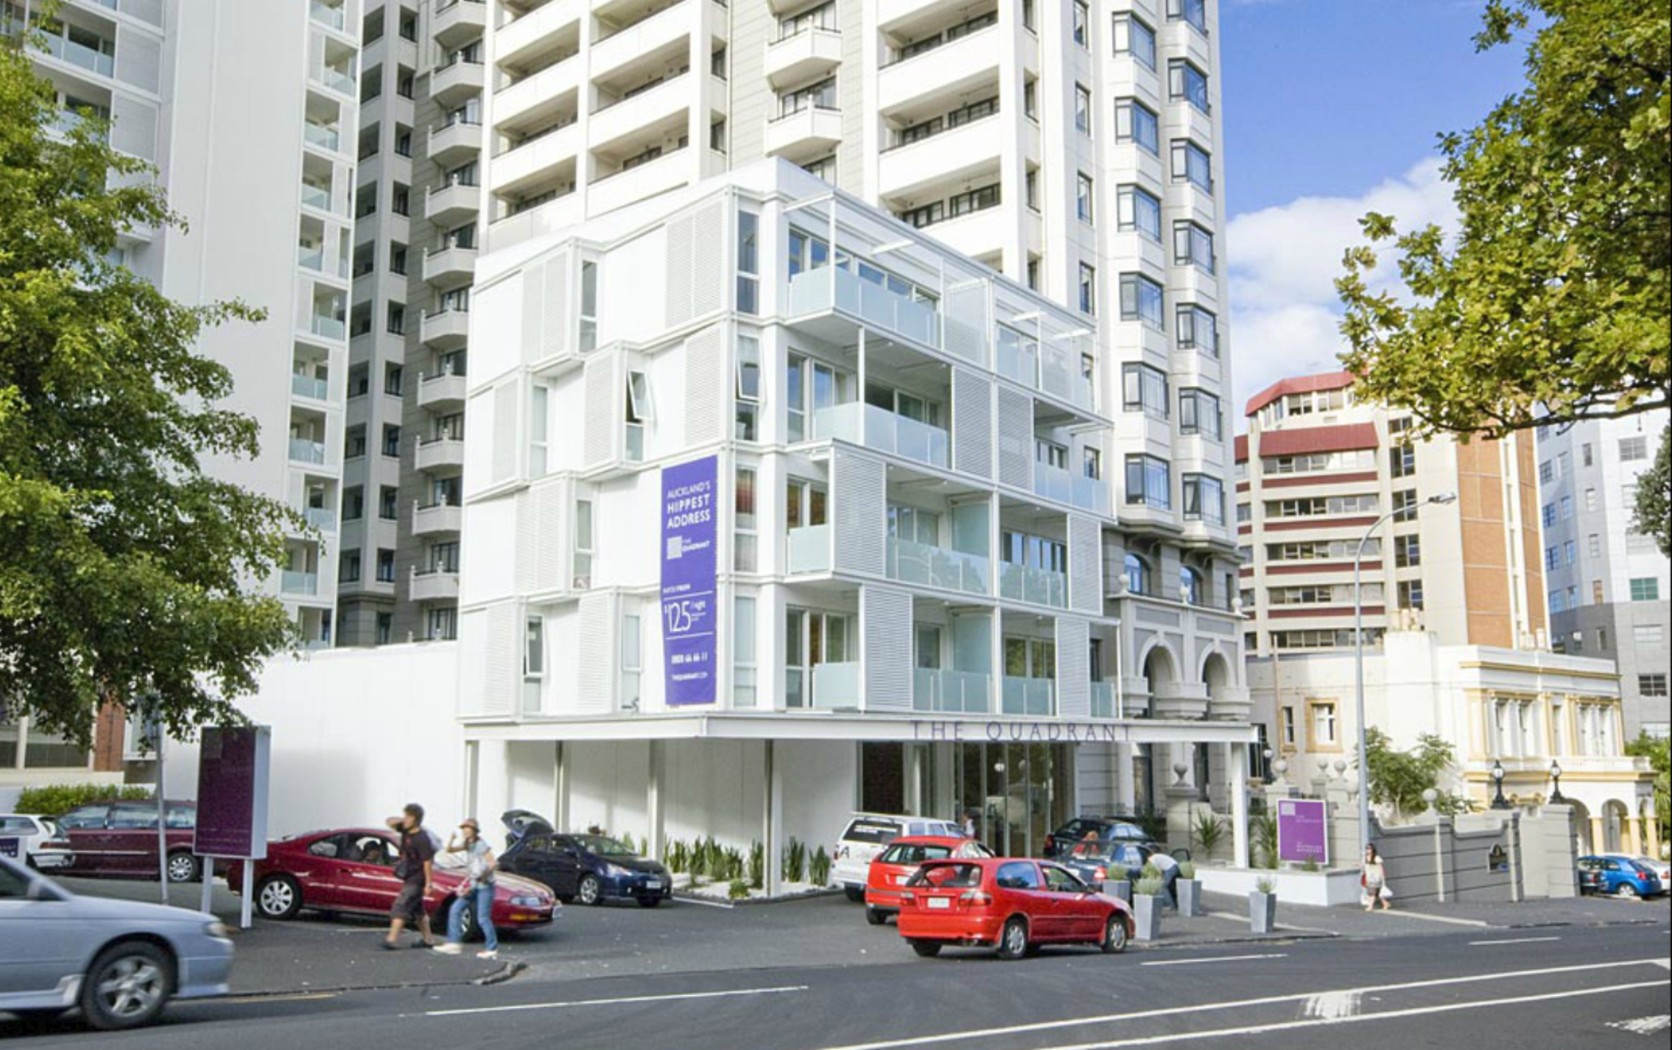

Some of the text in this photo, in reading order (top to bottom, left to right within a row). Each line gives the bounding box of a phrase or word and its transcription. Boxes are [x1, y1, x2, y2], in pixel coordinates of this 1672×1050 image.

[667, 493, 711, 514] HIPPEST
[667, 508, 711, 529] ADDRESS
[910, 719, 1132, 742] THE QUADRANT
